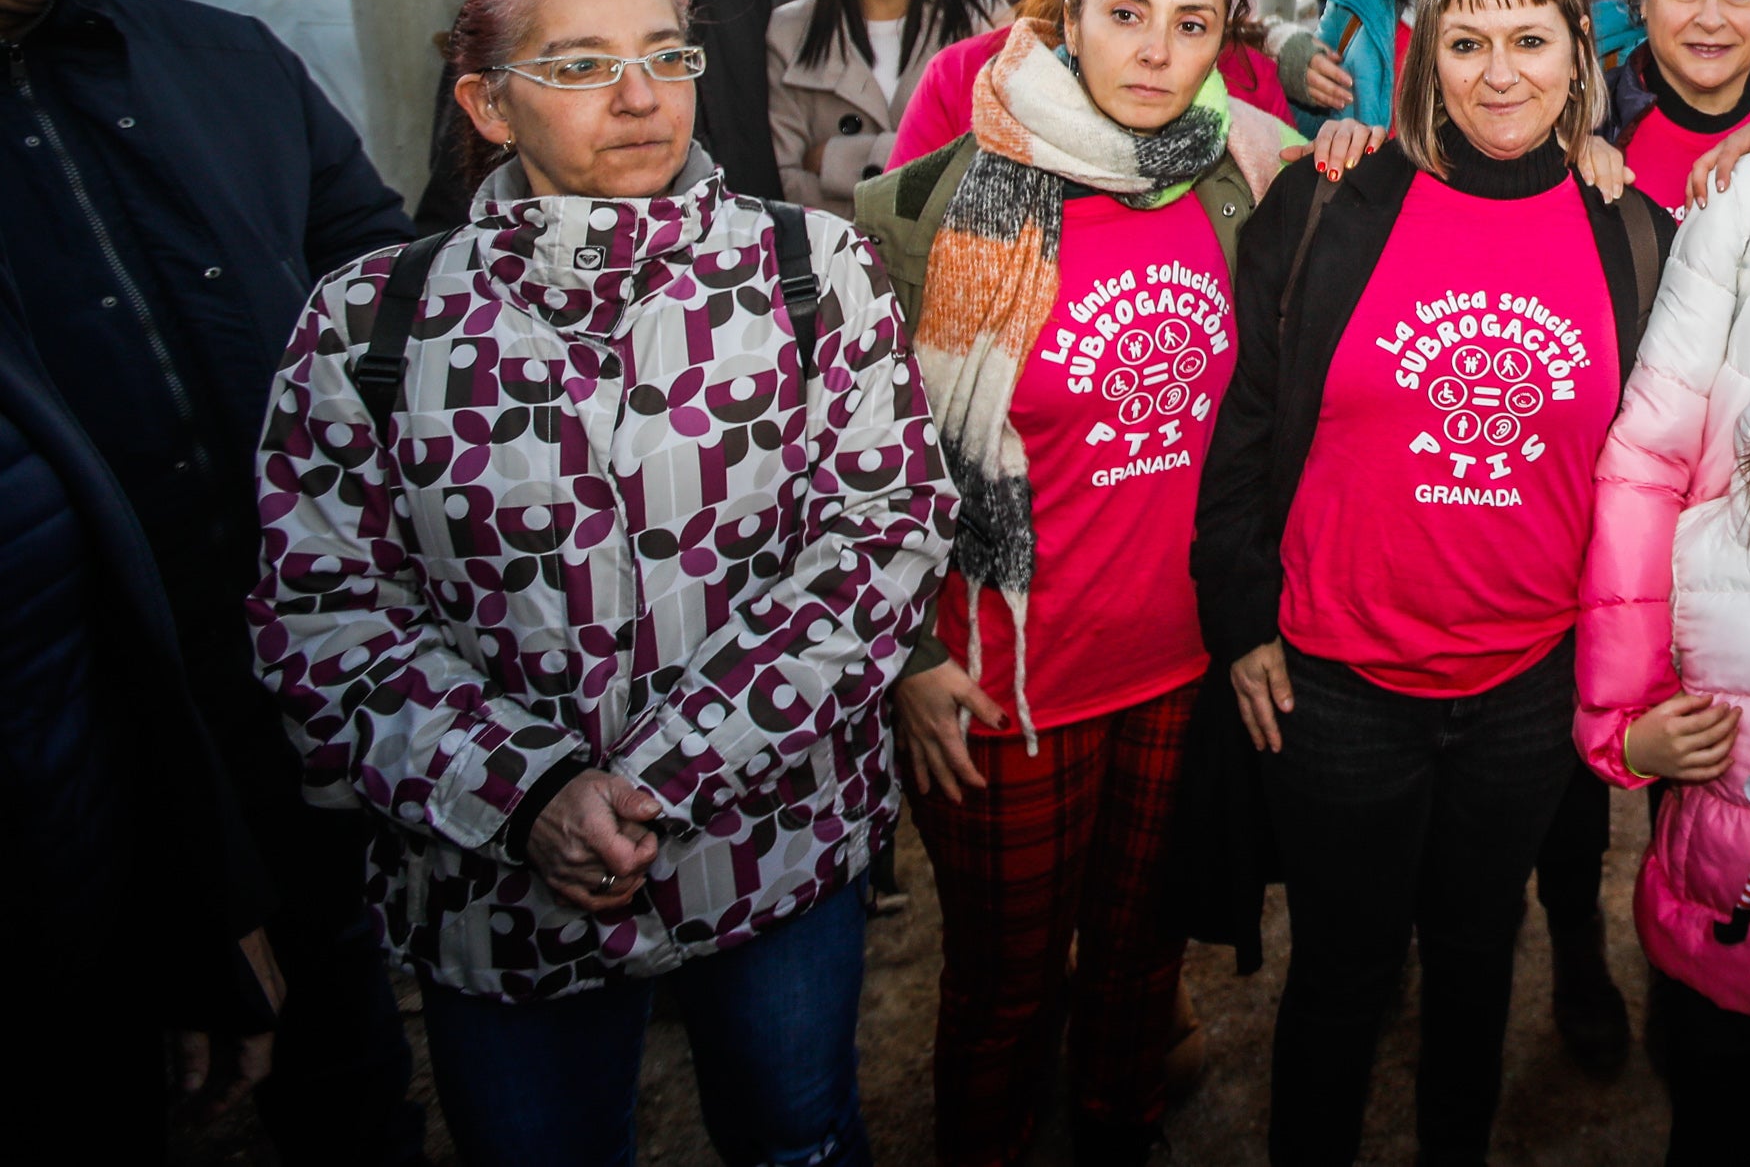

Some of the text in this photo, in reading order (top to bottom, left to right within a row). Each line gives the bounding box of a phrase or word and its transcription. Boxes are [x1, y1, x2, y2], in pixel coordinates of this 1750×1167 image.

[1040, 260, 1230, 365] La única solución:
[1067, 288, 1230, 394] SUBROGACIÓN
[1375, 289, 1591, 369] La única solución:
[1395, 313, 1576, 401] SUBROGACIÓN
[1091, 450, 1191, 487] GRANADA
[1414, 484, 1523, 507] GRANADA
